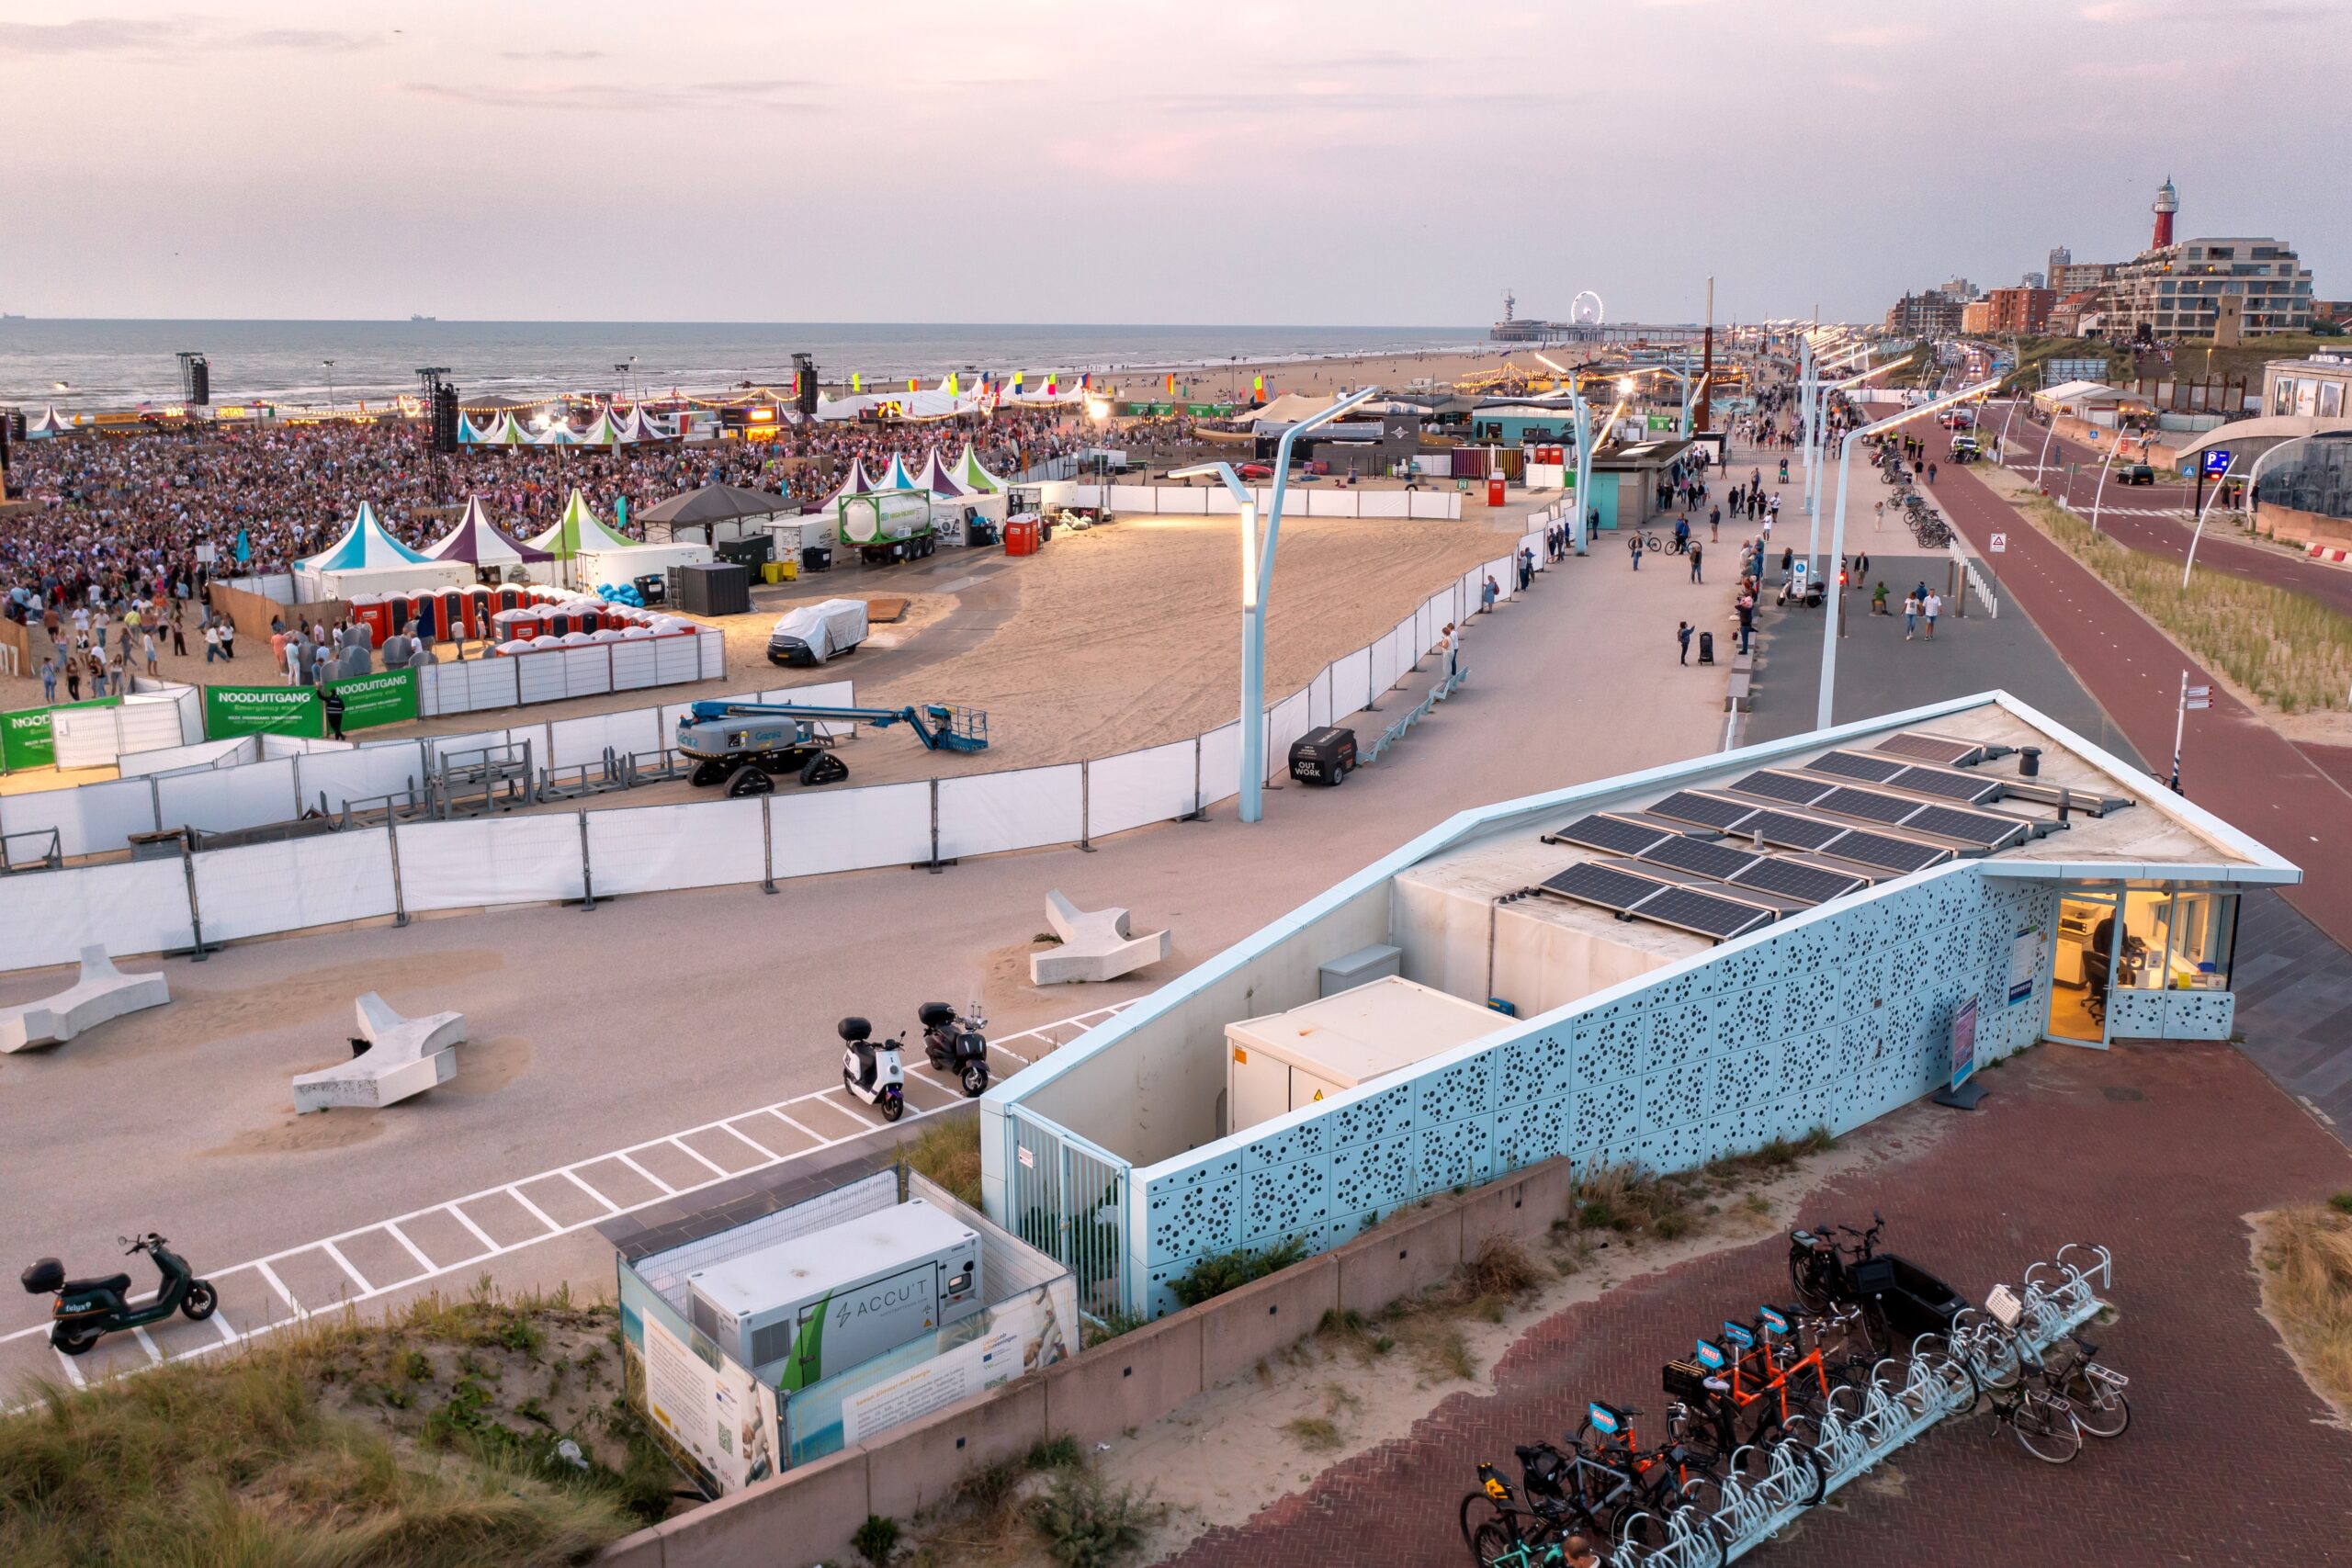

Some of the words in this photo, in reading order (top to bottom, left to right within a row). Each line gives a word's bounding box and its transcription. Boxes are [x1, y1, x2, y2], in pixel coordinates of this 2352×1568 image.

[166, 407, 185, 417] BBQ
[2207, 453, 2217, 466] P
[335, 675, 407, 695] NOODUITGANG
[219, 692, 311, 703] NOODUITGANG
[233, 704, 280, 713] Emergency
[755, 729, 783, 741] Genie
[1298, 761, 1316, 770] OUT
[1295, 767, 1321, 777] WORK
[65, 1303, 86, 1313] felyx
[1701, 1345, 1720, 1361] FREE!
